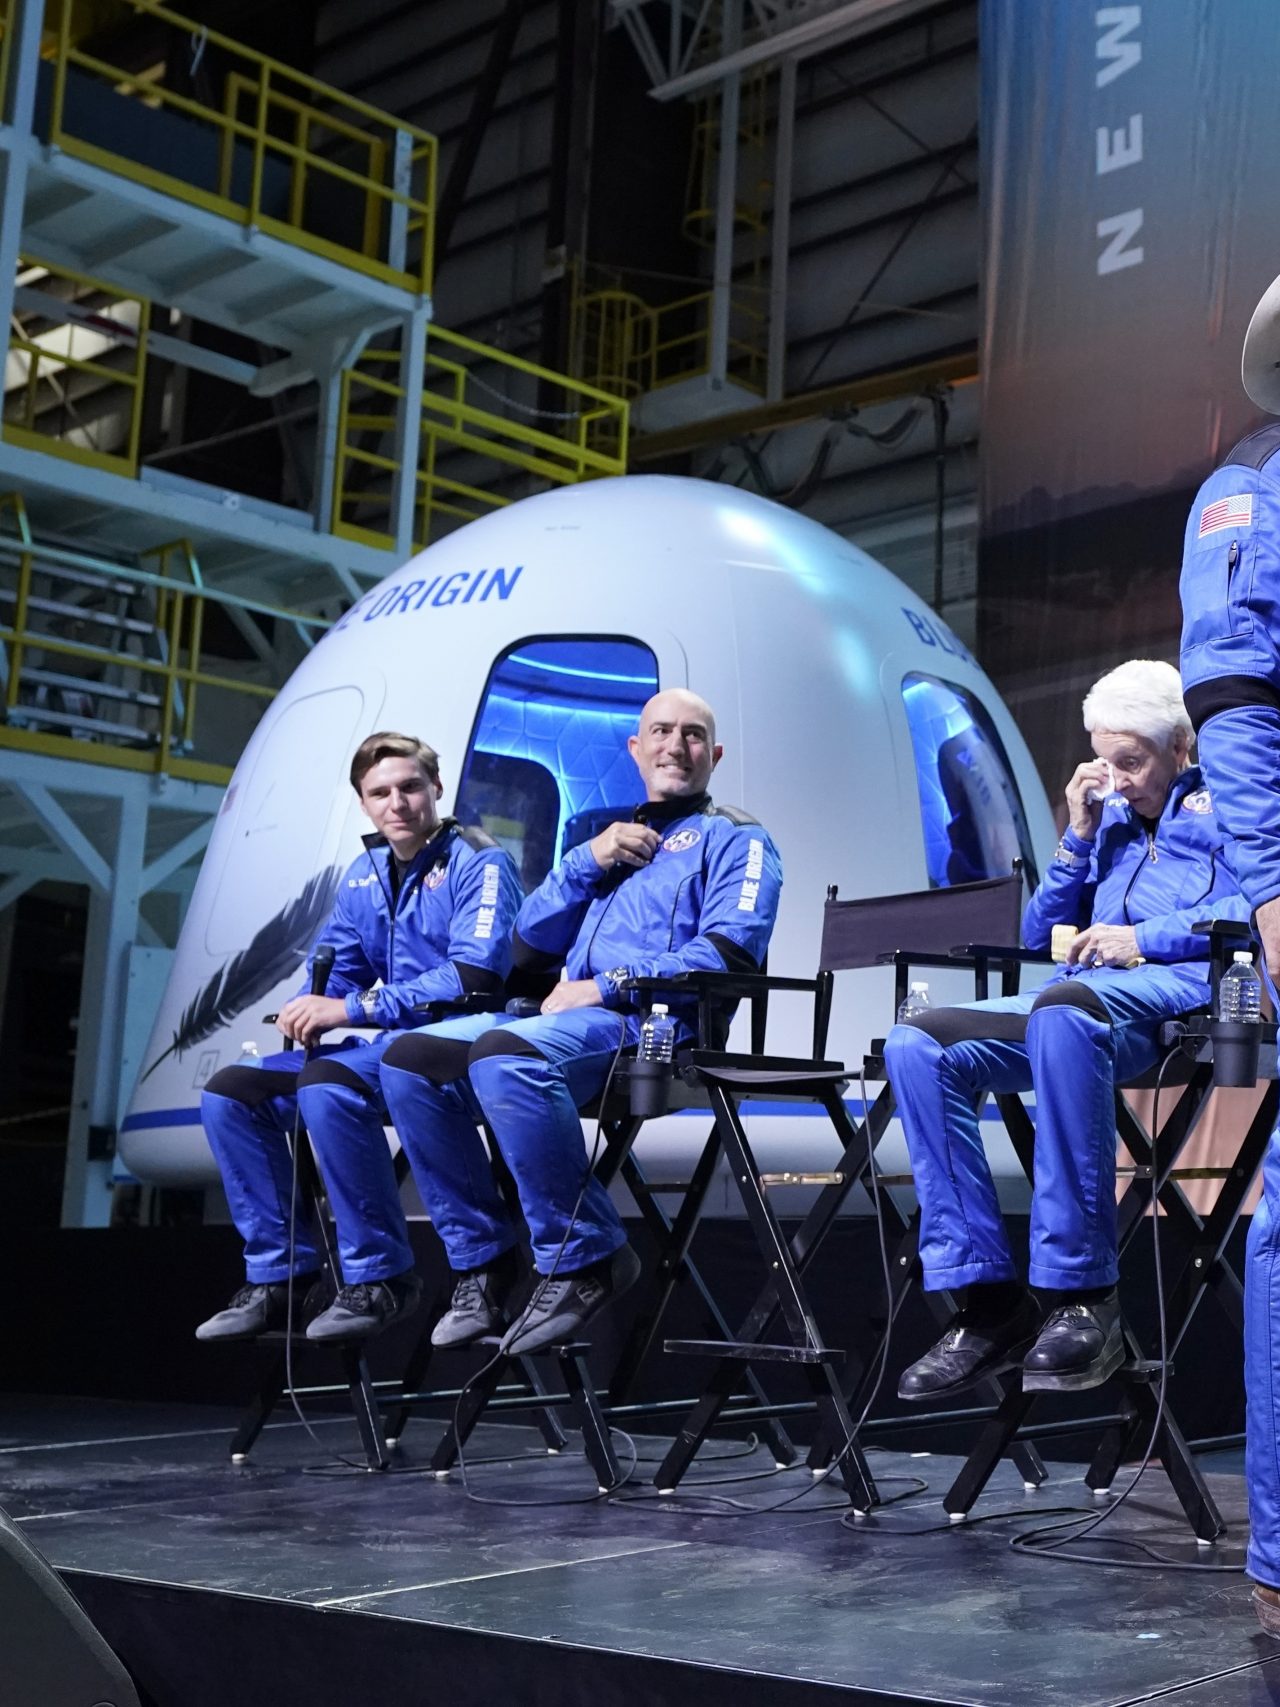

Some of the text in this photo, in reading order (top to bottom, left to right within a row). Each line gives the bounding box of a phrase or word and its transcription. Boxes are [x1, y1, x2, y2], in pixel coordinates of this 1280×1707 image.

[1096, 5, 1144, 275] NEW
[363, 566, 523, 622] ORIGIN
[901, 607, 981, 671] BL
[474, 863, 500, 938] BLUE ORIGIN
[737, 838, 764, 912] BLUE ORIGIN
